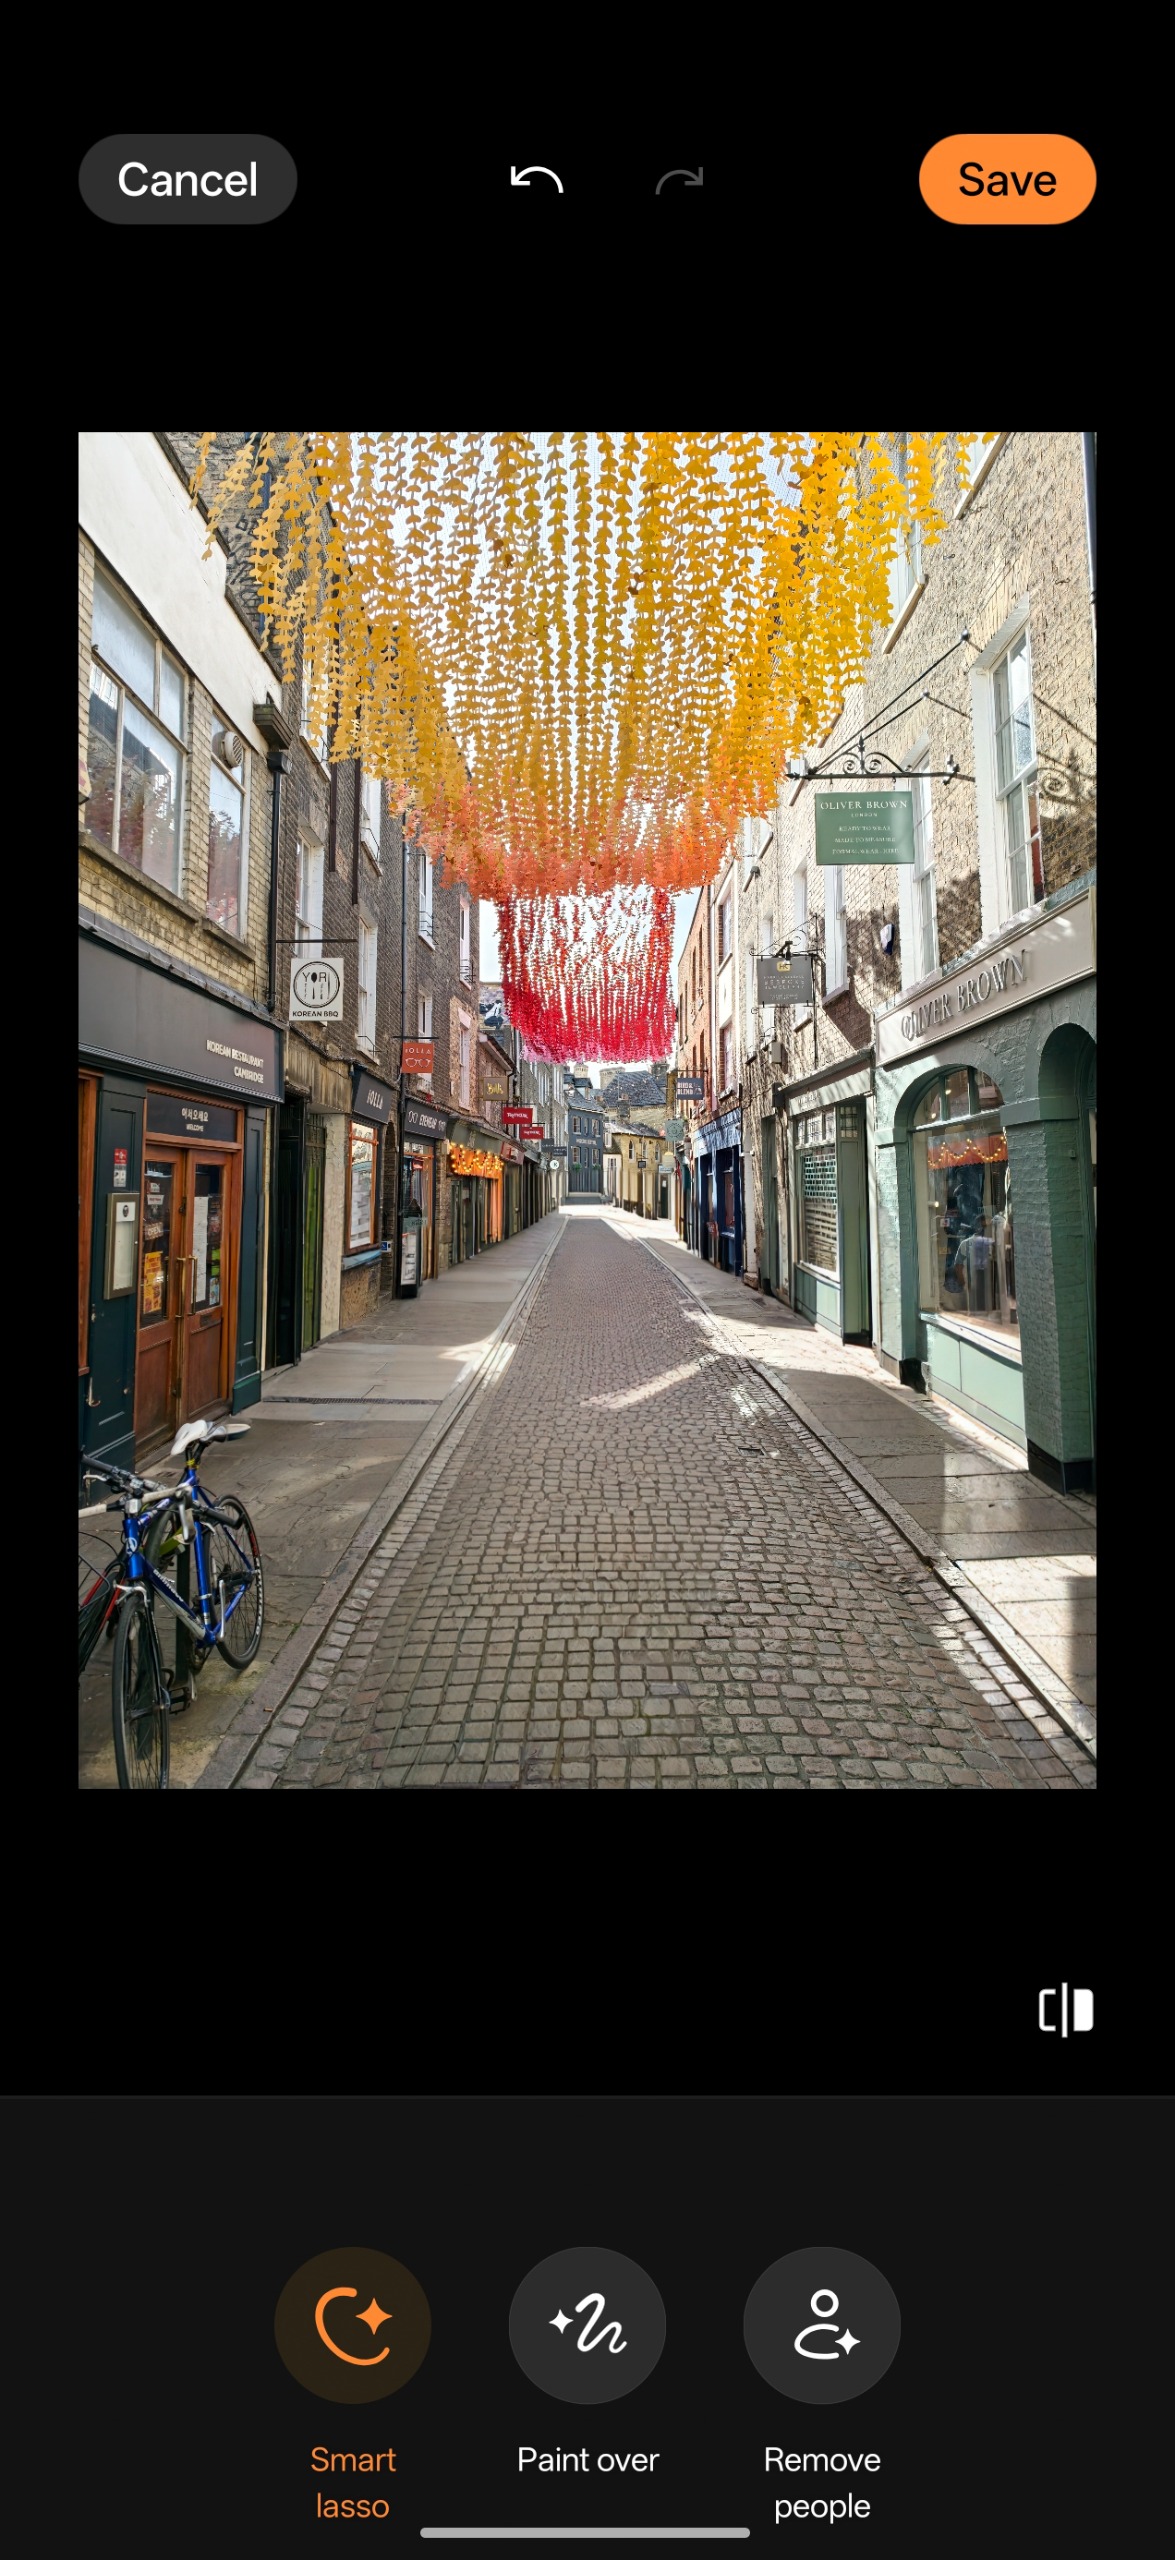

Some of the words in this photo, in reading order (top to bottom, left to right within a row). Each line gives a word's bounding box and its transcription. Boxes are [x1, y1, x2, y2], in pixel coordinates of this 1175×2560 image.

[820, 801, 862, 810] OLIVER
[866, 800, 907, 809] BROWN
[901, 993, 954, 1041] OLIVER
[957, 949, 1029, 1013] BROWN
[323, 1010, 339, 1018] BBQ
[206, 1039, 232, 1059] KOREAN
[231, 1048, 265, 1069] RESTAURANT
[233, 1066, 265, 1084] CAMBRIDGE
